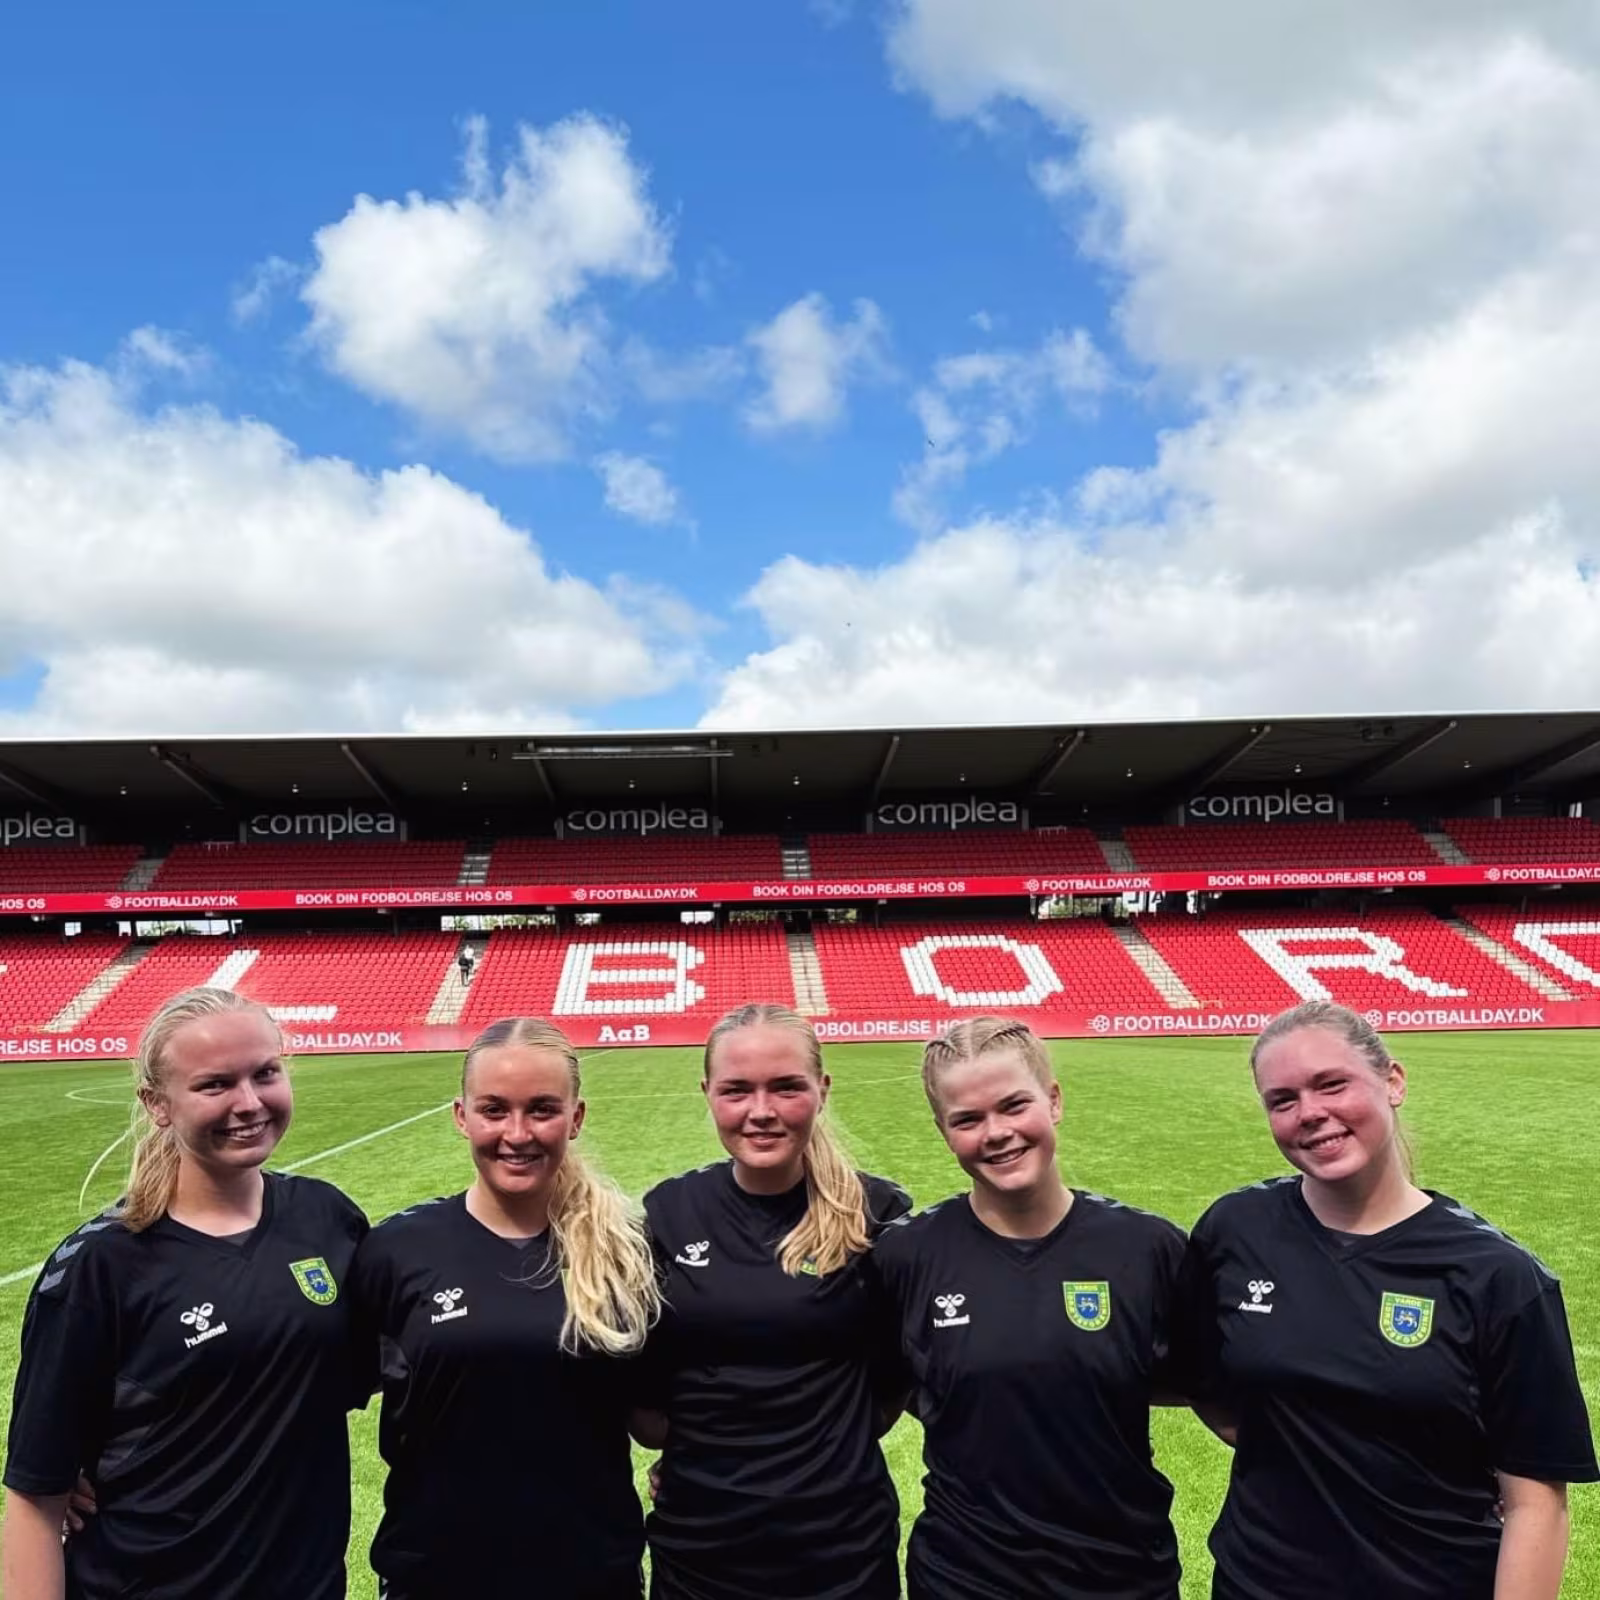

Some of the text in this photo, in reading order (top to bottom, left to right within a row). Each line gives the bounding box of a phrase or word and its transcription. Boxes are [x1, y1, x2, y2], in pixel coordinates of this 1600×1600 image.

[878, 795, 1017, 830] complea
[1190, 788, 1334, 822] complea
[251, 806, 395, 841] complea
[568, 801, 708, 836] complea
[0, 811, 75, 846] plea
[1042, 877, 1151, 890] FOOTBALLDAY.DK
[1208, 870, 1426, 886] BOOK DIN FODBOLDREJSE HOS OS
[296, 890, 513, 905] BOOK DIN FODBOLDREJSE HOS OS
[589, 887, 698, 900] FOOTBALLDAY.DK
[753, 881, 966, 897] BOOK DIN FODBOLDREJSE HOS OS
[27, 898, 46, 909] OS
[124, 896, 239, 908] FOOTBALLDAY.DK
[1114, 1013, 1272, 1031] FOOTBALLDAY.DK
[1387, 1008, 1545, 1025] FOOTBALLDAY.DK
[598, 1024, 651, 1042] AaB
[57, 1038, 97, 1053] HOS
[100, 1037, 128, 1052] OS
[184, 1321, 228, 1349] hummel
